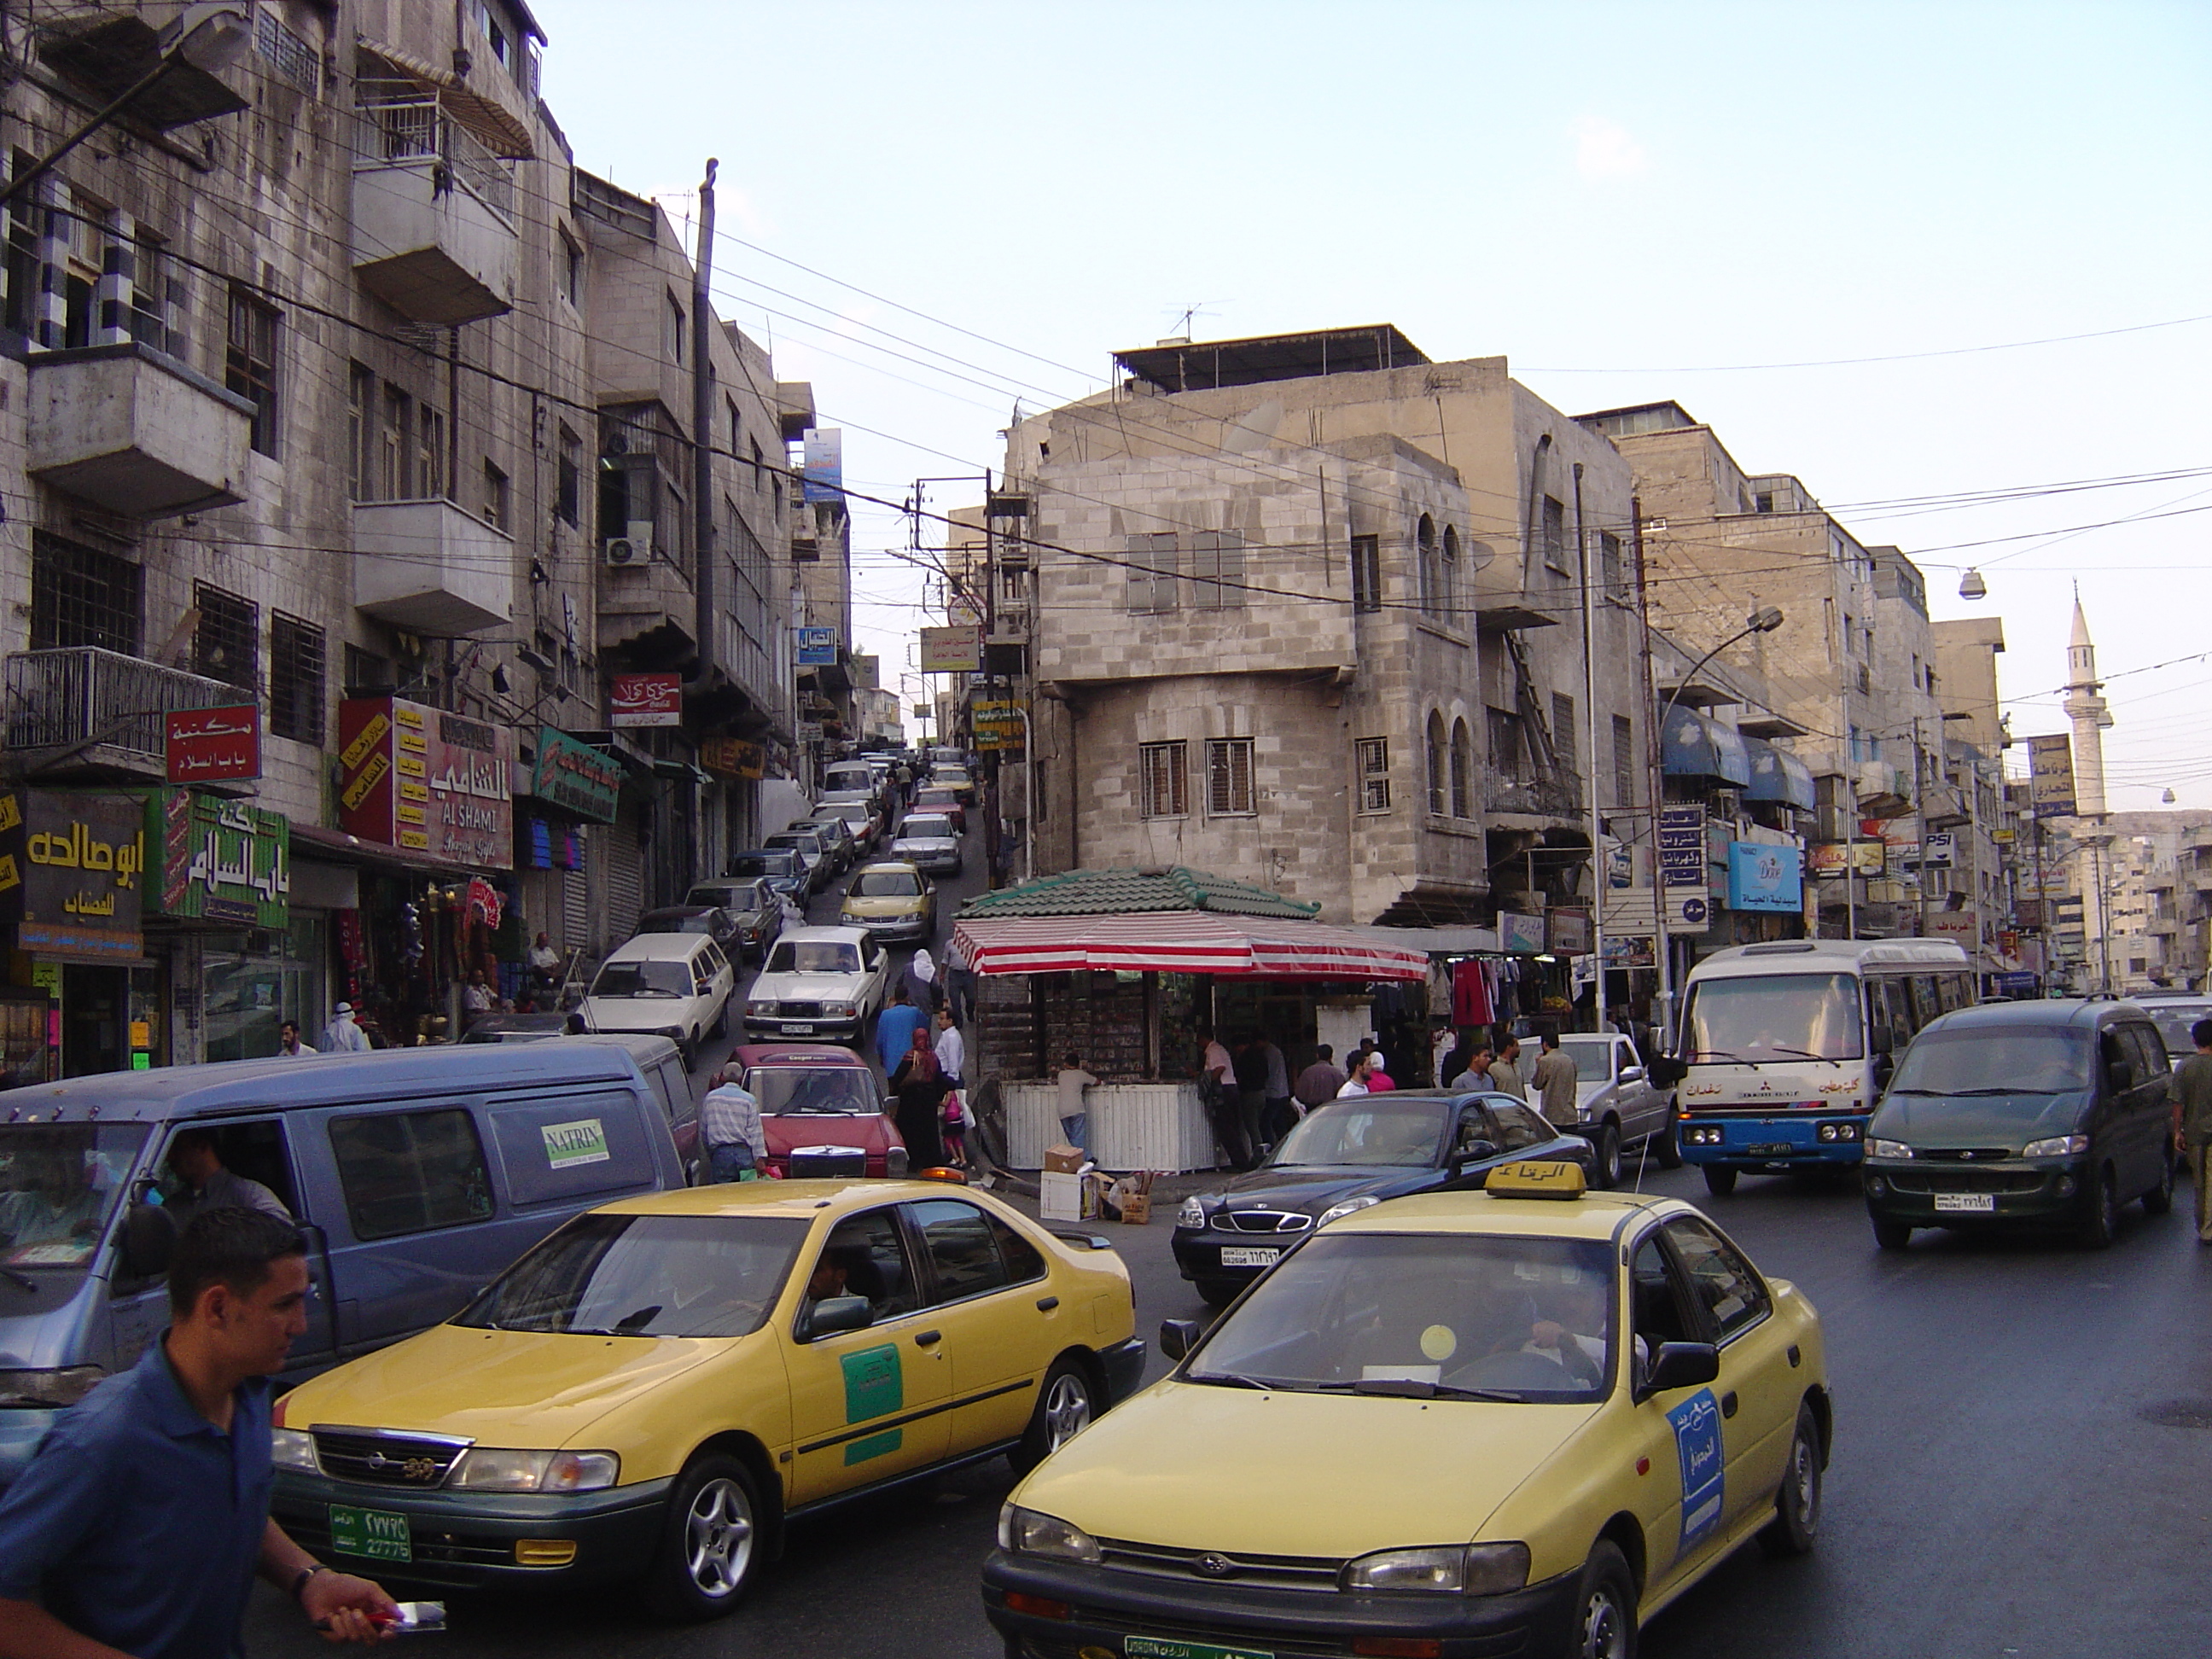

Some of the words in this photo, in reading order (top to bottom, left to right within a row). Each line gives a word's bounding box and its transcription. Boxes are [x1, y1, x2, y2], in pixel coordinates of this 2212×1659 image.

[172, 717, 252, 745] مكتبة
[178, 752, 218, 776] السلام
[218, 750, 247, 771] باب
[430, 754, 510, 800] الشامي
[2037, 782, 2072, 800] التجاري
[218, 803, 256, 835] مكتبة
[442, 802, 456, 825] AL
[458, 805, 497, 834] SHAMI
[1927, 834, 1952, 846] PSI
[188, 830, 253, 894] السلام
[253, 843, 290, 906] باب
[1759, 860, 1781, 879] Dove
[1743, 894, 1768, 905] الحياة
[1770, 895, 1797, 906] صيدلية
[546, 1126, 600, 1154] NATRIN
[365, 1513, 407, 1540] ٢٧٧٧٥
[367, 1538, 409, 1557] 27775
